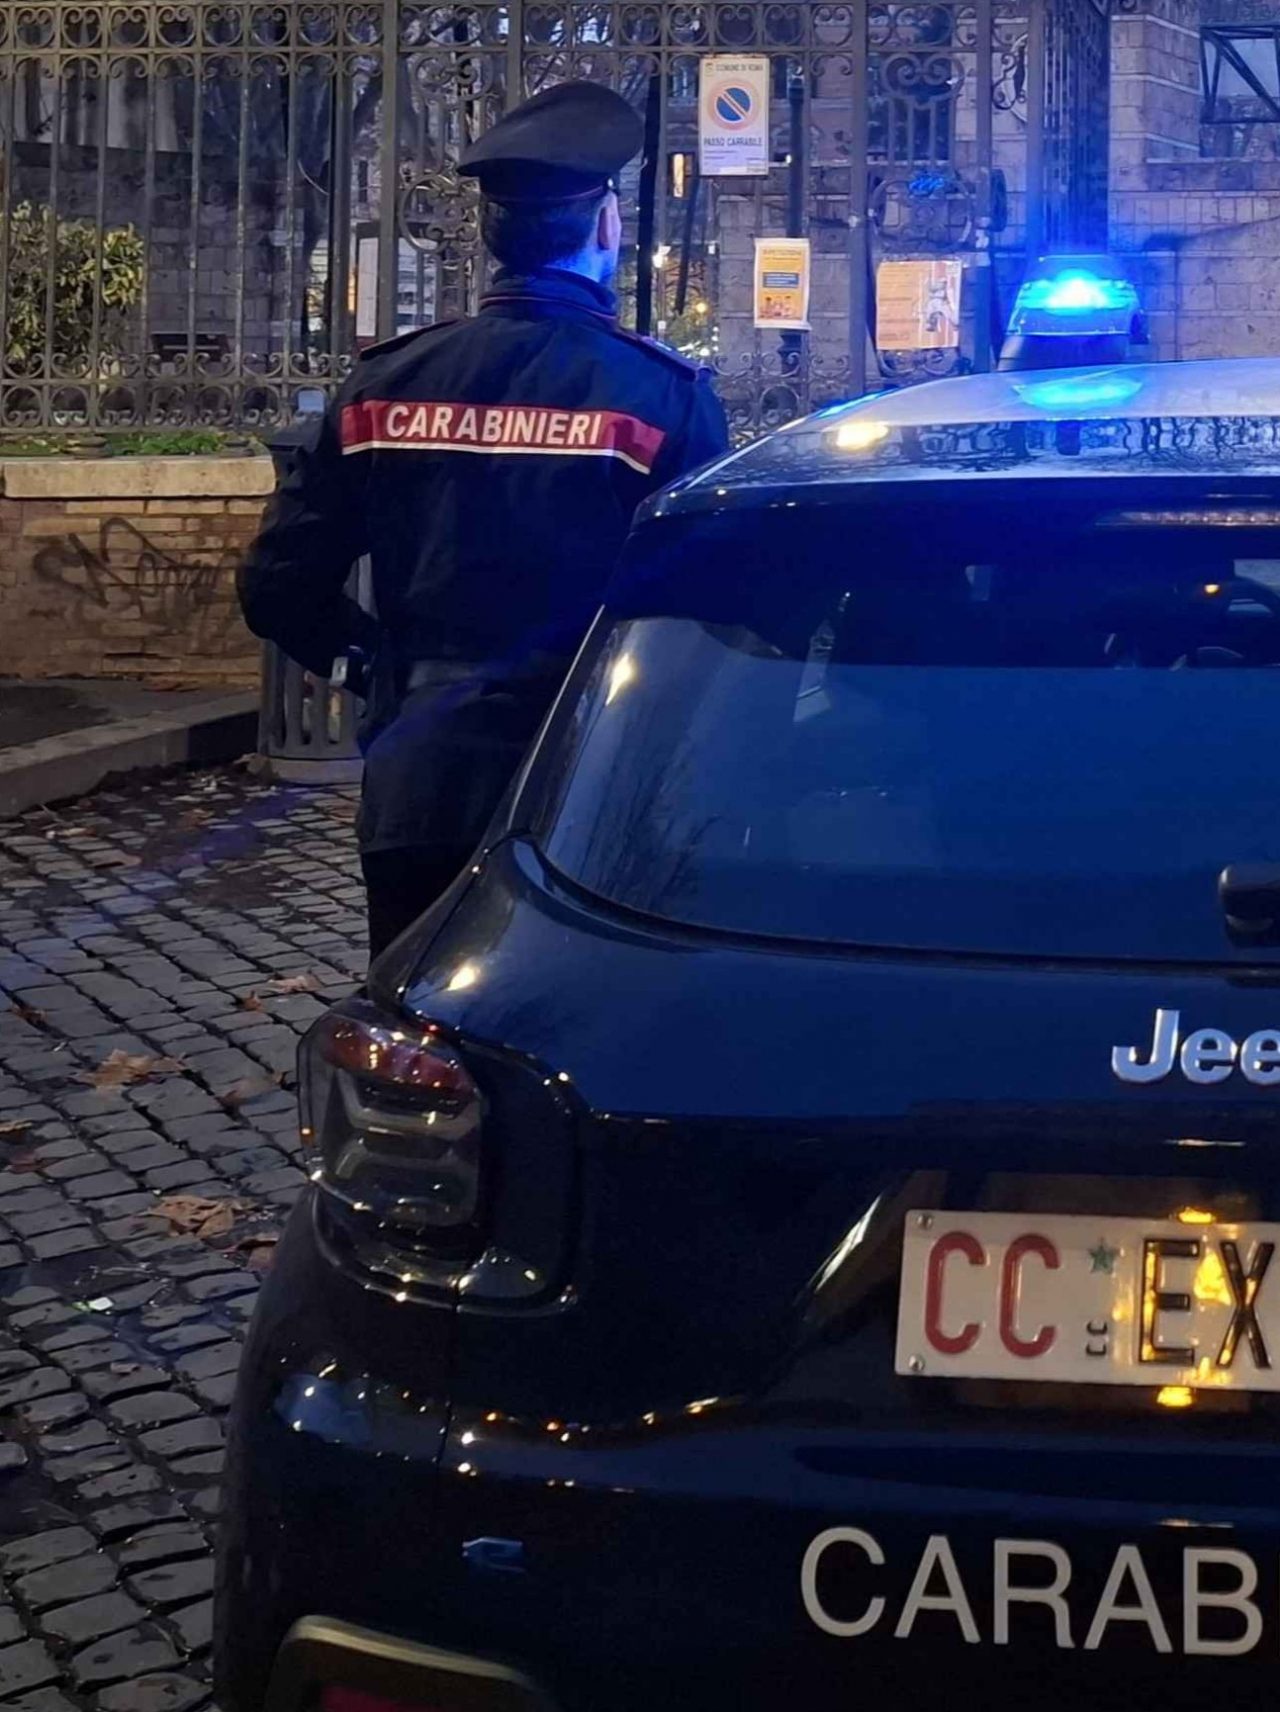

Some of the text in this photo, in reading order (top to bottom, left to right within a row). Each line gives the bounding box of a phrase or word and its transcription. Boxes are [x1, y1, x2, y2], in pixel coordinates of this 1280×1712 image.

[385, 404, 602, 446] CARABINIERI
[923, 1230, 1061, 1359] CC
[1138, 1237, 1275, 1370] EX
